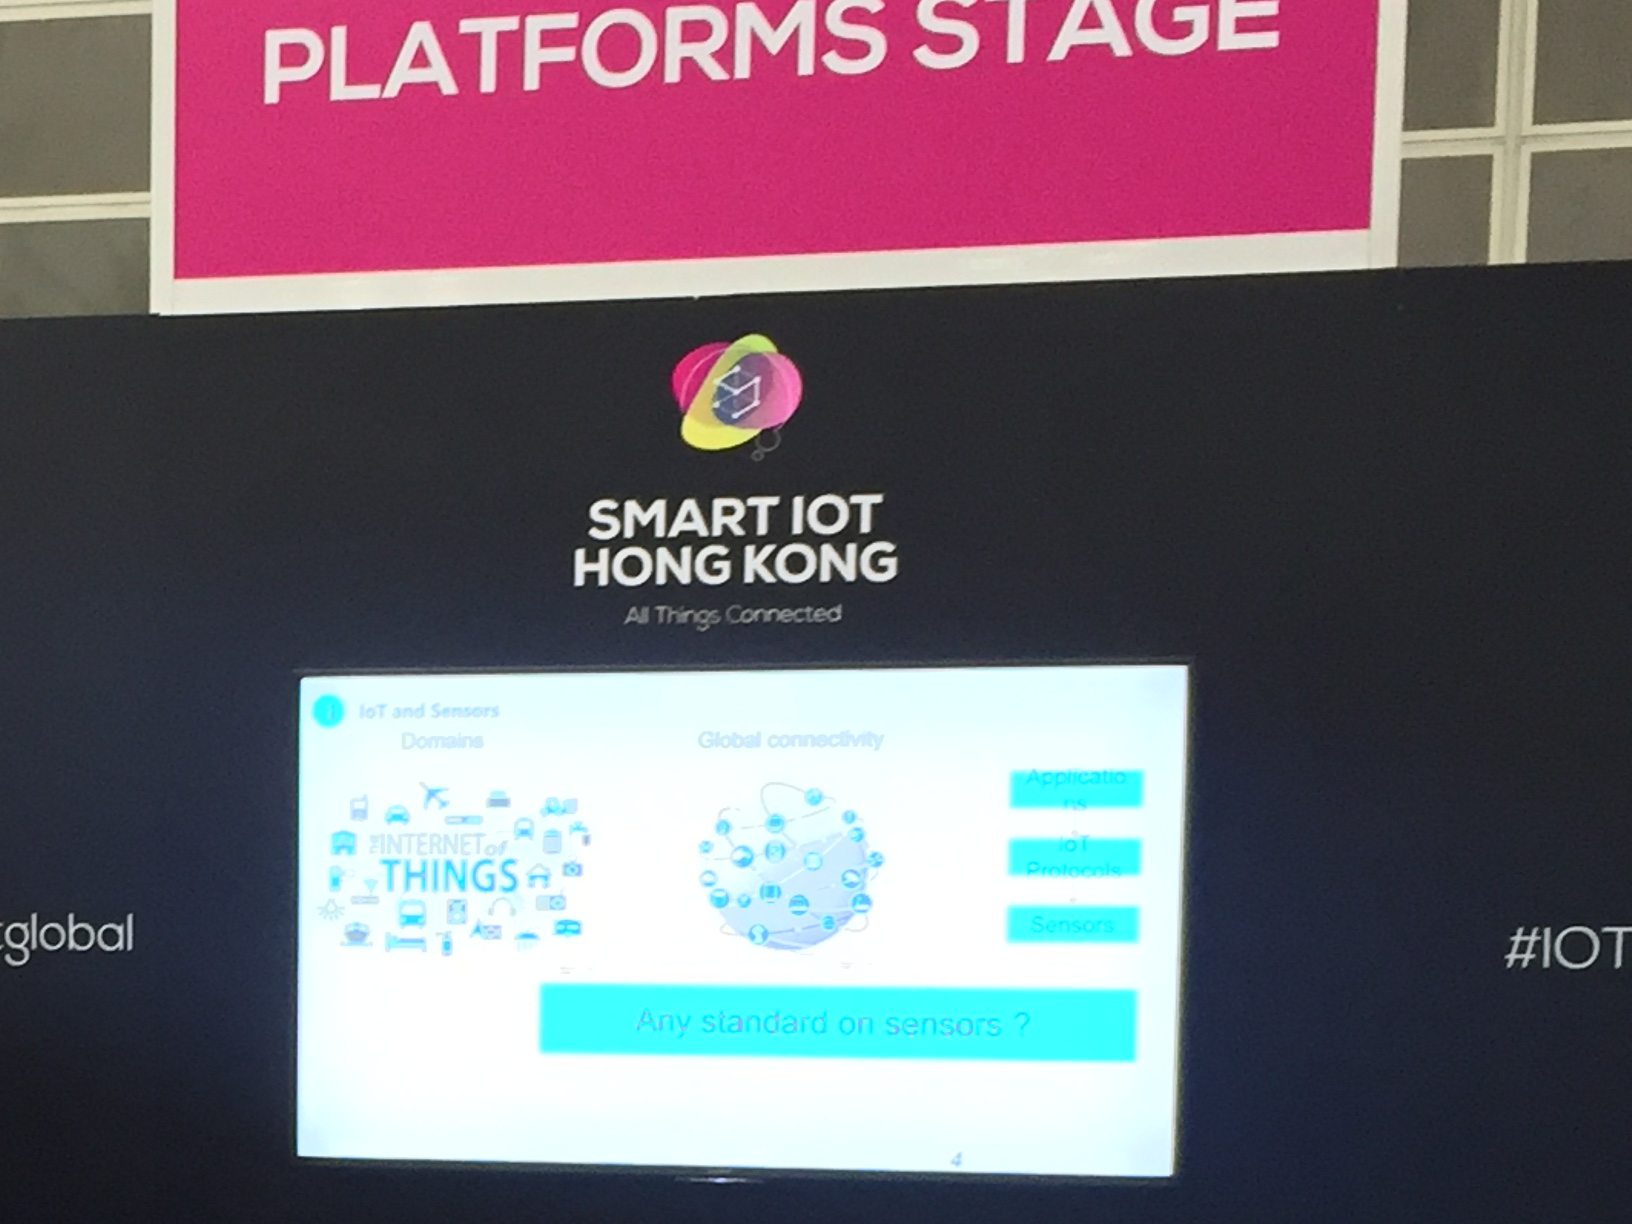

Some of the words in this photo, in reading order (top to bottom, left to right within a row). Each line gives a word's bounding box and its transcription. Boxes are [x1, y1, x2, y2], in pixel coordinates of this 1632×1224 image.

[263, 0, 888, 104] PLATFORMS
[912, 0, 1280, 70] STAGE
[587, 496, 780, 541] SMART
[791, 493, 885, 535] IOT
[573, 546, 732, 587] HONG
[742, 541, 898, 584] KONG
[624, 606, 649, 624] All
[655, 605, 720, 632] Things
[726, 604, 843, 624] Connected
[359, 703, 387, 719] IoT
[393, 703, 425, 719] and
[431, 703, 500, 719] Sensors
[401, 732, 484, 750] Domains
[698, 731, 761, 749] Global
[767, 730, 884, 751] connectivity
[1026, 768, 1127, 789] Applicatio
[380, 832, 486, 856] INTERNET
[380, 858, 518, 893] THINGS
[1026, 861, 1123, 879] Protocols
[1031, 916, 1114, 933] Sensors
[1504, 925, 1632, 970] #IOT
[636, 1008, 691, 1039] Any
[701, 1010, 828, 1035] standard
[839, 1016, 874, 1035] on
[885, 1016, 1003, 1037] sensors
[1014, 1012, 1031, 1037] ?
